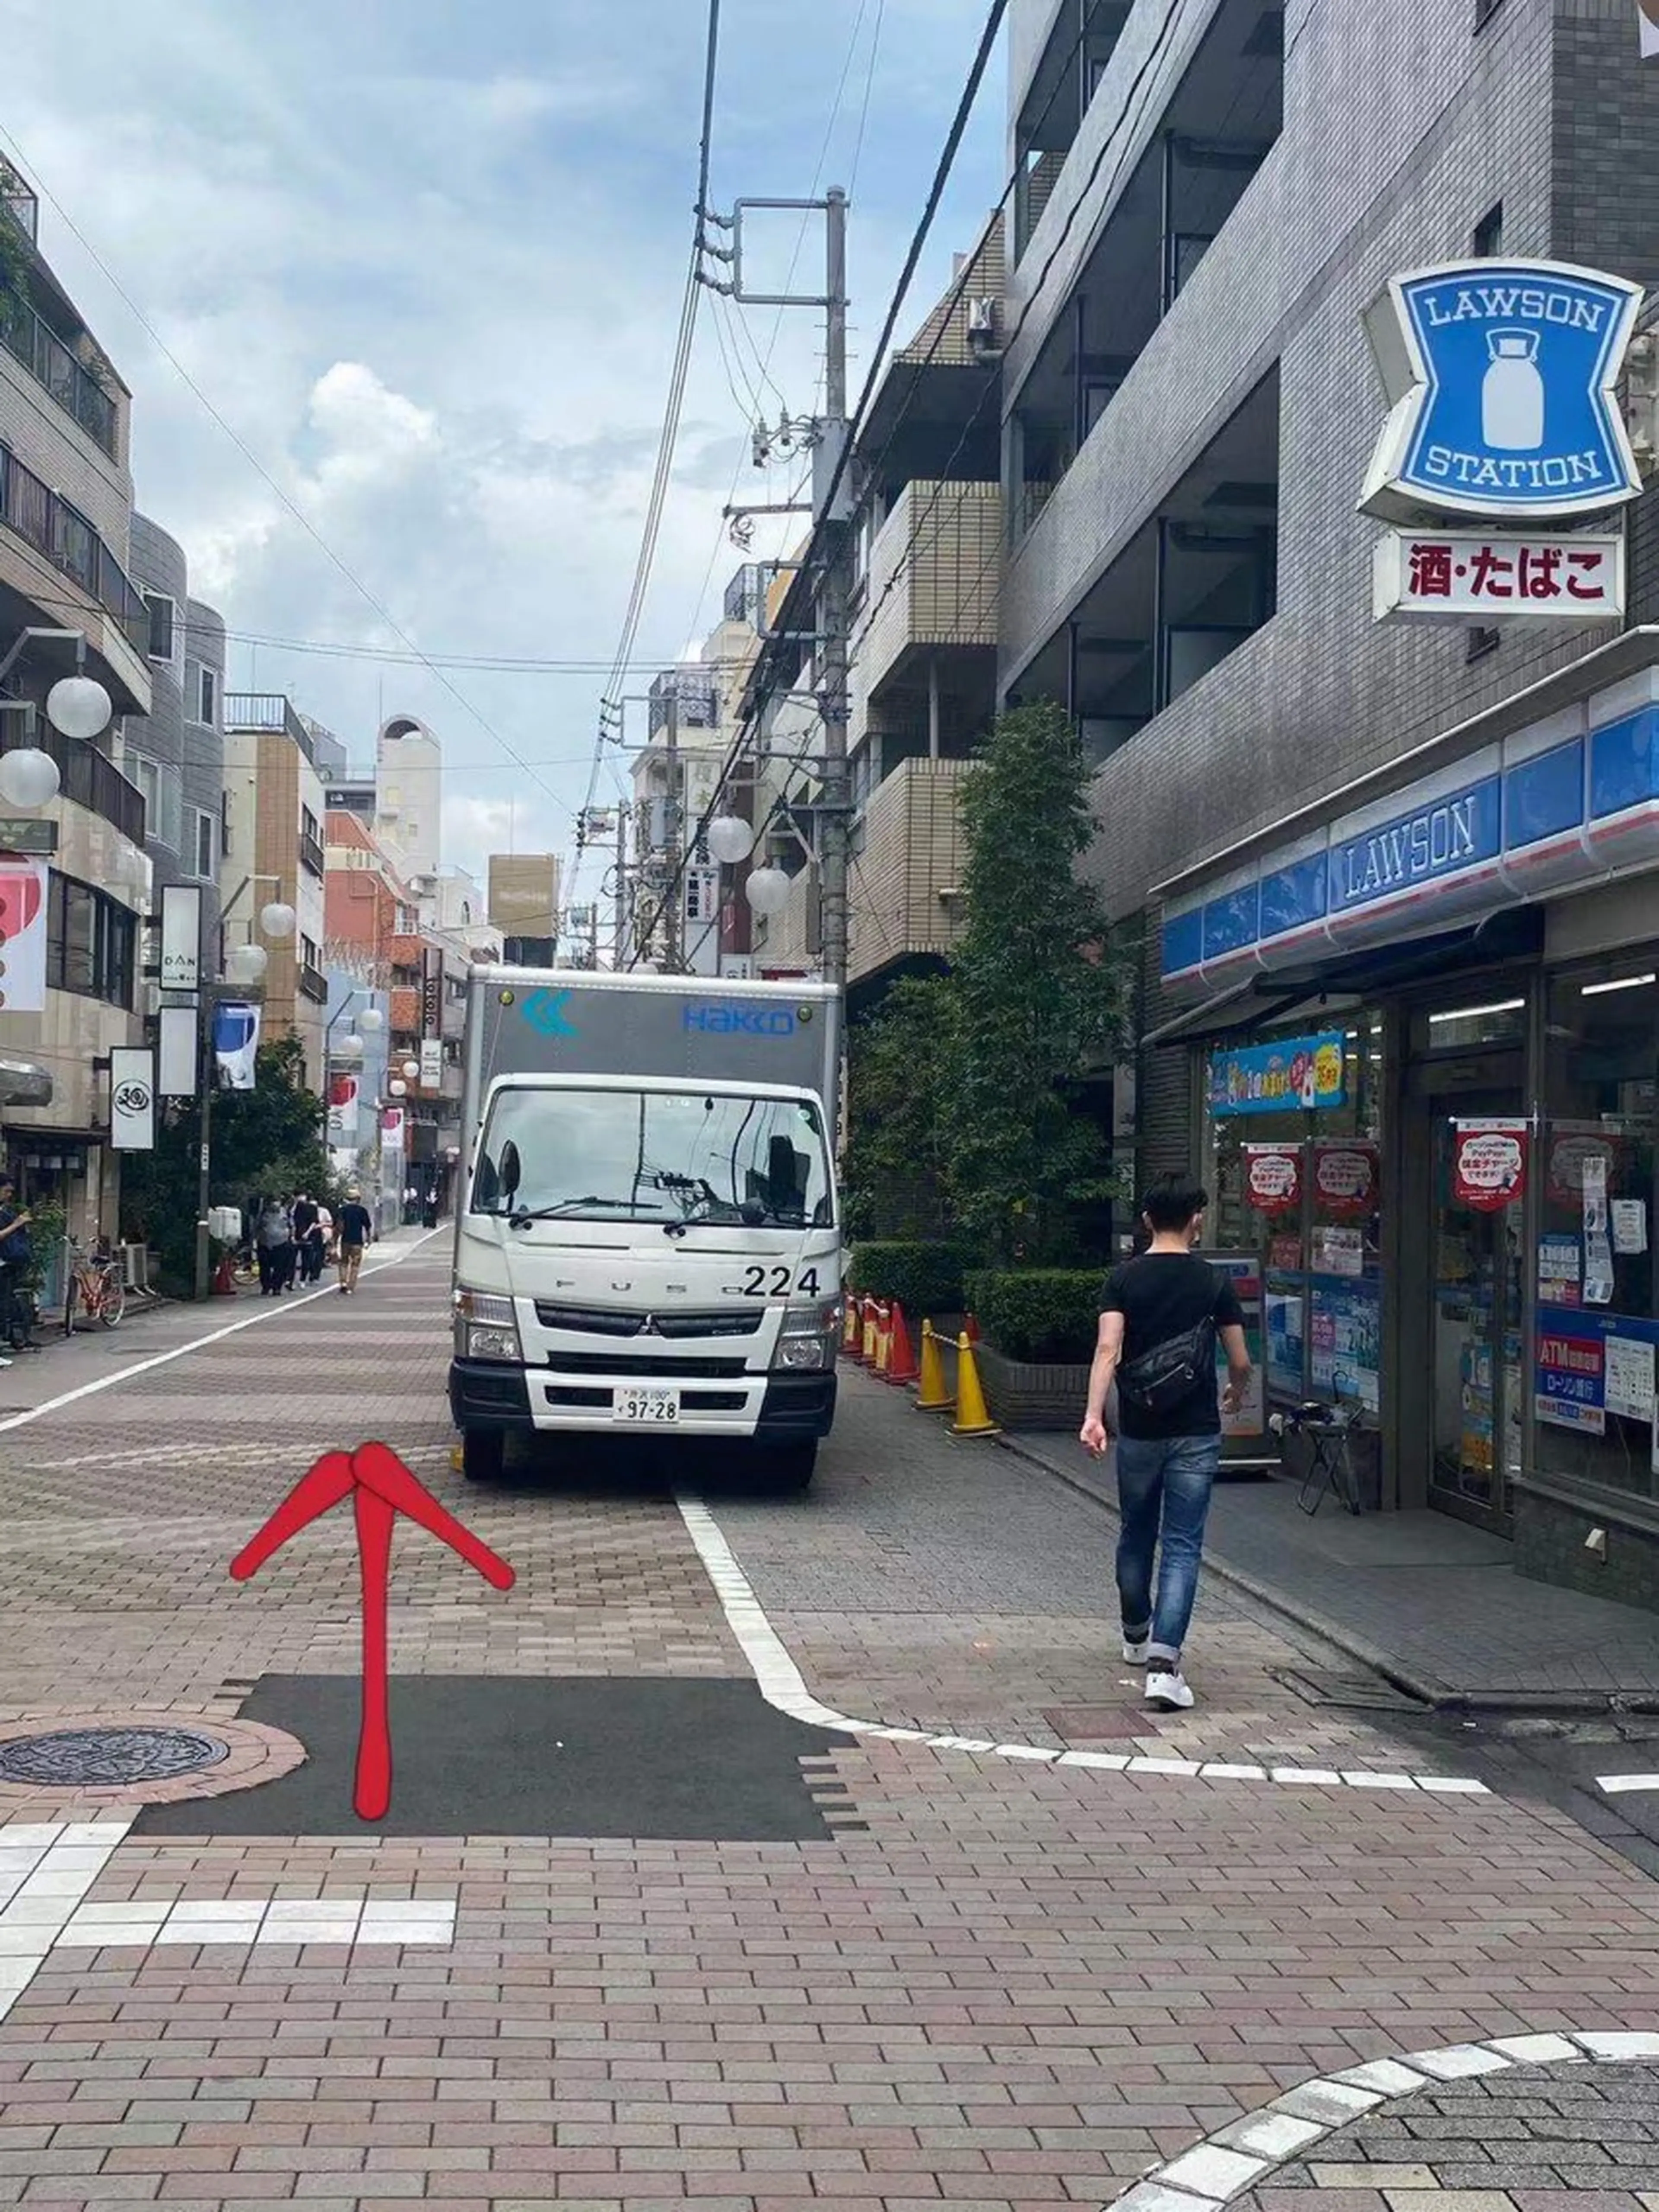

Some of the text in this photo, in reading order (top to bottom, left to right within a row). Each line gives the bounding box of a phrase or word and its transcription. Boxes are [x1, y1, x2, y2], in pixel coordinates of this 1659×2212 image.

[1424, 288, 1606, 333] LAWSON
[1425, 445, 1602, 488] STATION
[1408, 543, 1604, 599] 酒・たばこ
[1345, 796, 1475, 899] LAWSON
[744, 1266, 820, 1297] 224
[1540, 1340, 1568, 1368] ATM
[628, 1401, 677, 1420] 97-28
